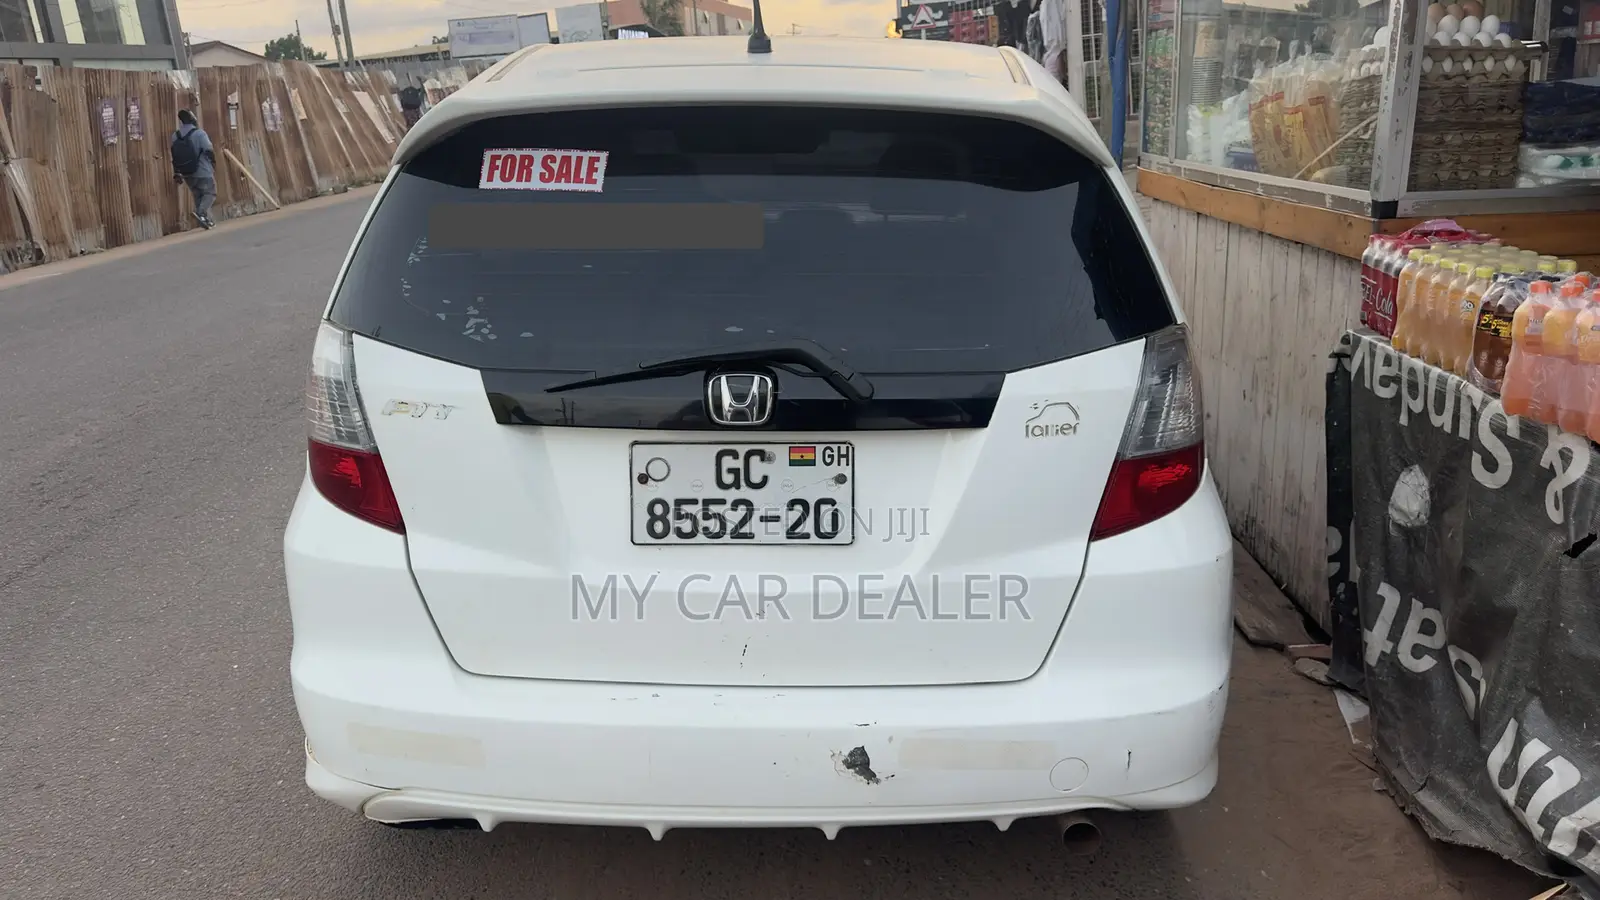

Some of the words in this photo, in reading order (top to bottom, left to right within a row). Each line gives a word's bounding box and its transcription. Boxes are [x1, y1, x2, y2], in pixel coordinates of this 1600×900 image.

[486, 154, 534, 183] FOR
[539, 154, 600, 185] SALE
[715, 449, 768, 490] GC
[822, 446, 850, 466] GH
[646, 498, 839, 540] 8552-20
